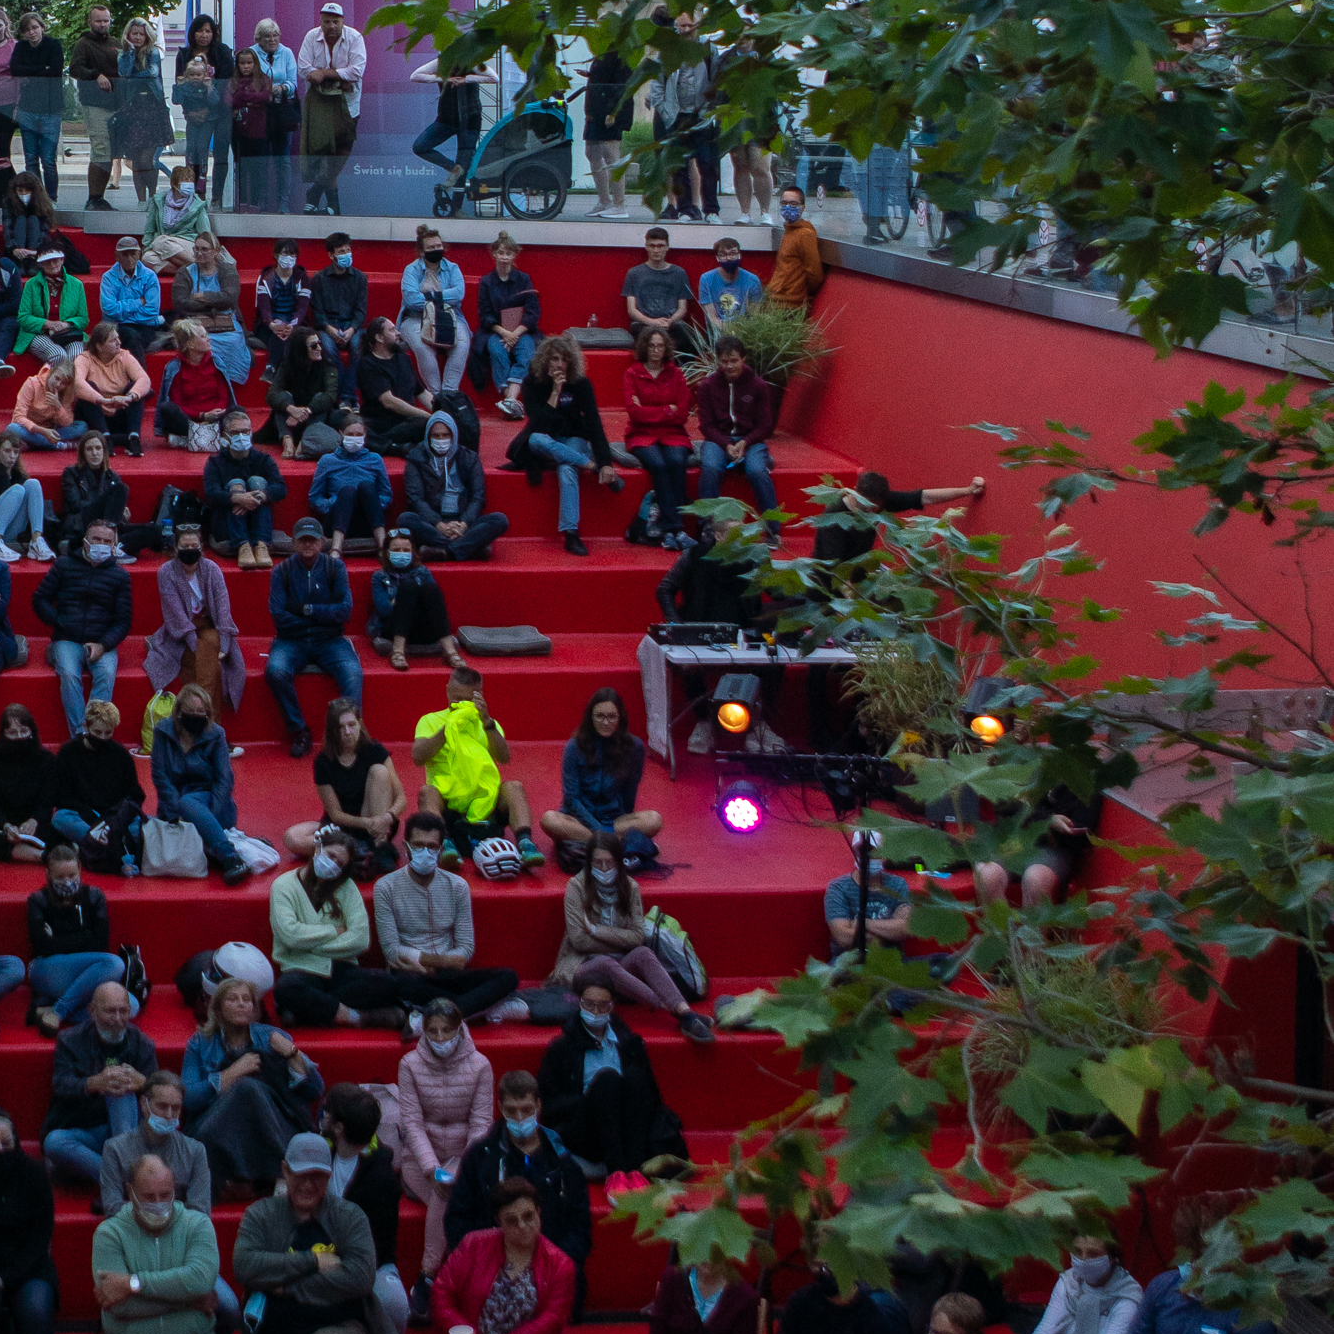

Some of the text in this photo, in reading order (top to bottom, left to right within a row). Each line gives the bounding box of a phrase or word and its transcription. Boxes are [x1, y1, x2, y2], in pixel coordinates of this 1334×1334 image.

[353, 163, 437, 177] Świat się budzi.
